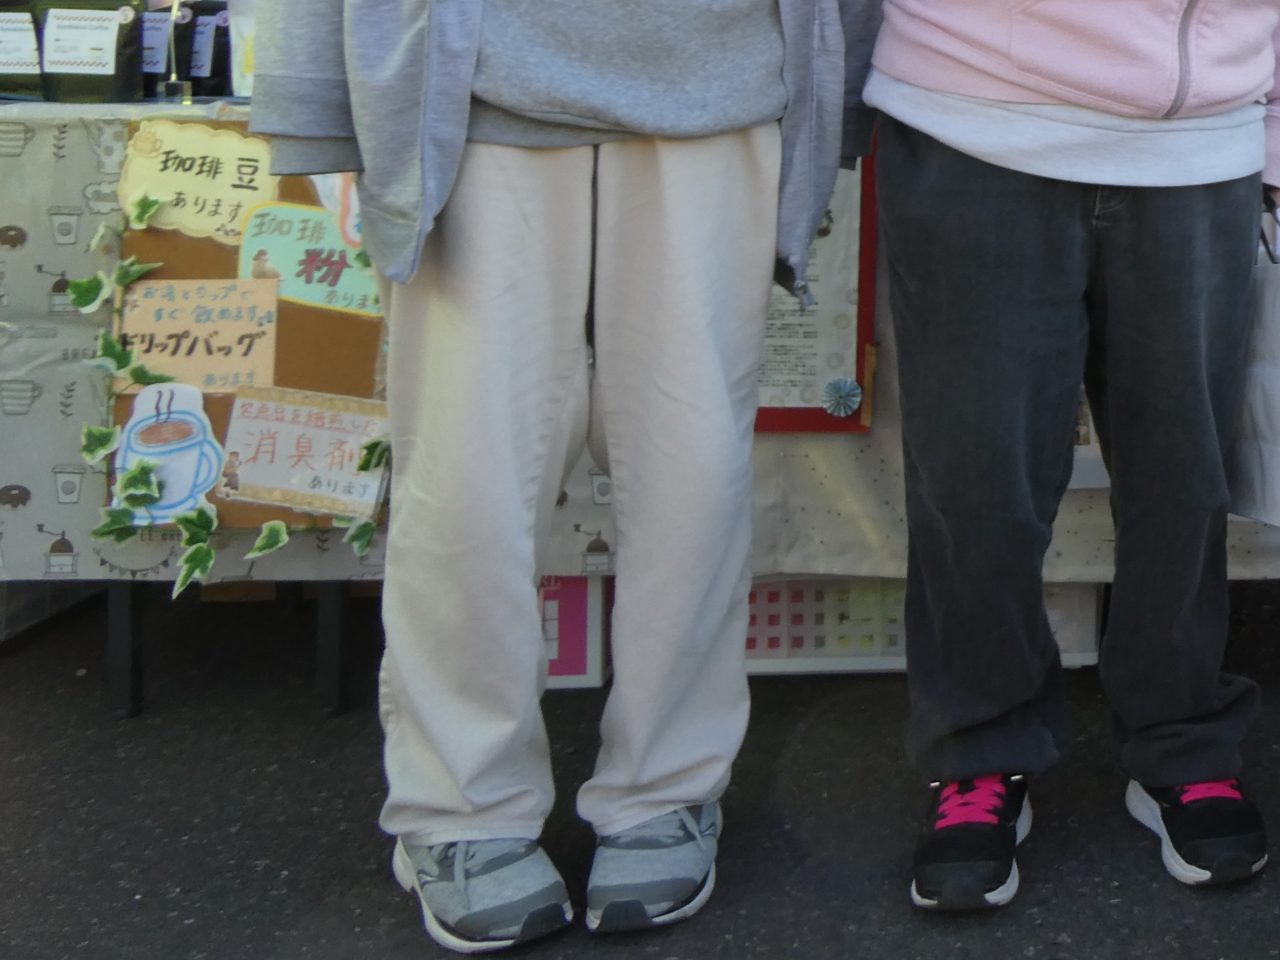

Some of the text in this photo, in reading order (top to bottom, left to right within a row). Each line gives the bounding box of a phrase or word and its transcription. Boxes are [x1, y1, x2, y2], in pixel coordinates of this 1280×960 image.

[170, 192, 243, 223] あります
[294, 247, 354, 288] 粉
[325, 290, 371, 309] ありま
[121, 329, 268, 357] ドリップバッグ
[243, 427, 362, 476] 消臭剤
[308, 474, 372, 498] あります
